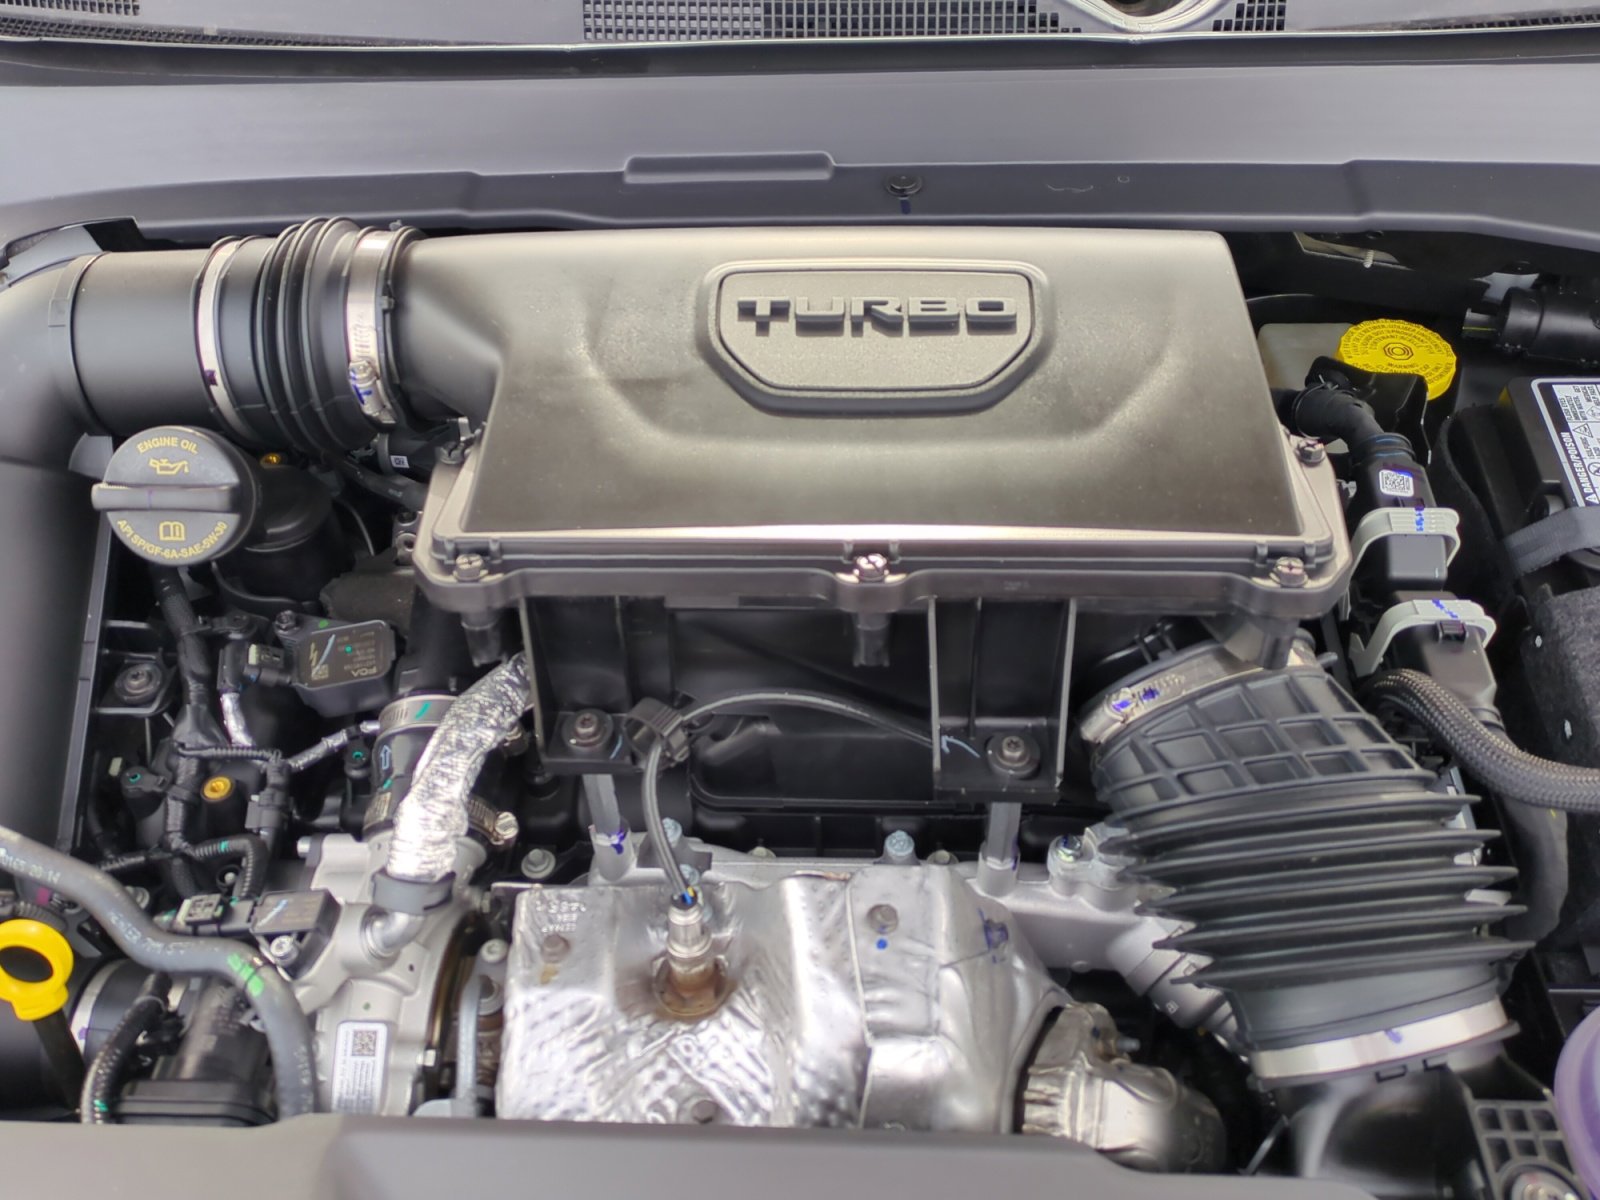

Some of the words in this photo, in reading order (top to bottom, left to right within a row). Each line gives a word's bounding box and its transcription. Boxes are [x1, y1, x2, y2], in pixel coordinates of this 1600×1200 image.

[737, 296, 1017, 337] TURBO
[136, 436, 178, 453] ENGINE
[180, 438, 199, 454] OIL
[1560, 431, 1594, 493] DANGER/POISON
[117, 519, 132, 537] API
